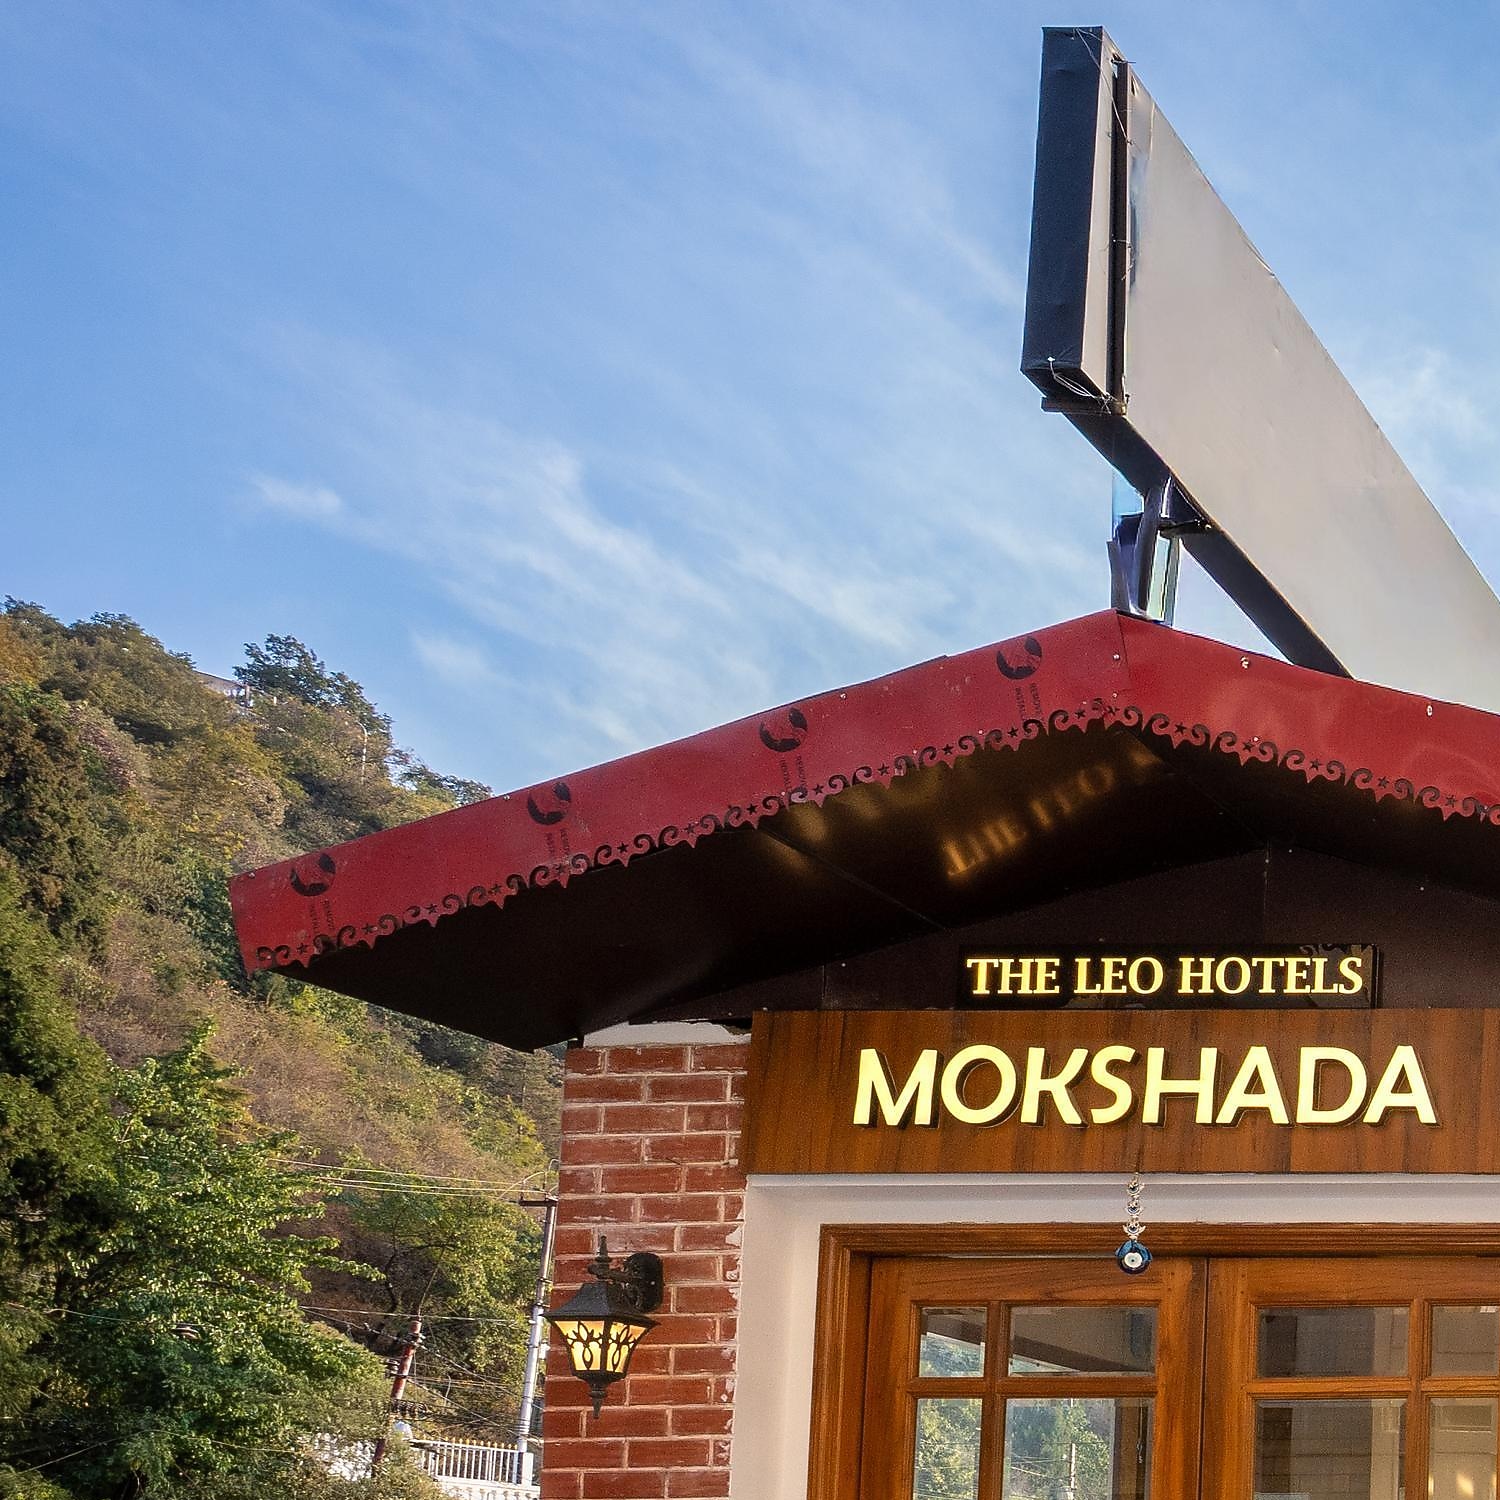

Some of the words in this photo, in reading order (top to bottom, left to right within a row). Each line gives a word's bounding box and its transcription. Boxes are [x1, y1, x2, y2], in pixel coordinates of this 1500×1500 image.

[966, 956, 1061, 995] THE
[1073, 955, 1165, 995] LEO
[1177, 955, 1364, 995] HOTELS
[852, 1043, 1438, 1126] MOKSHADA
